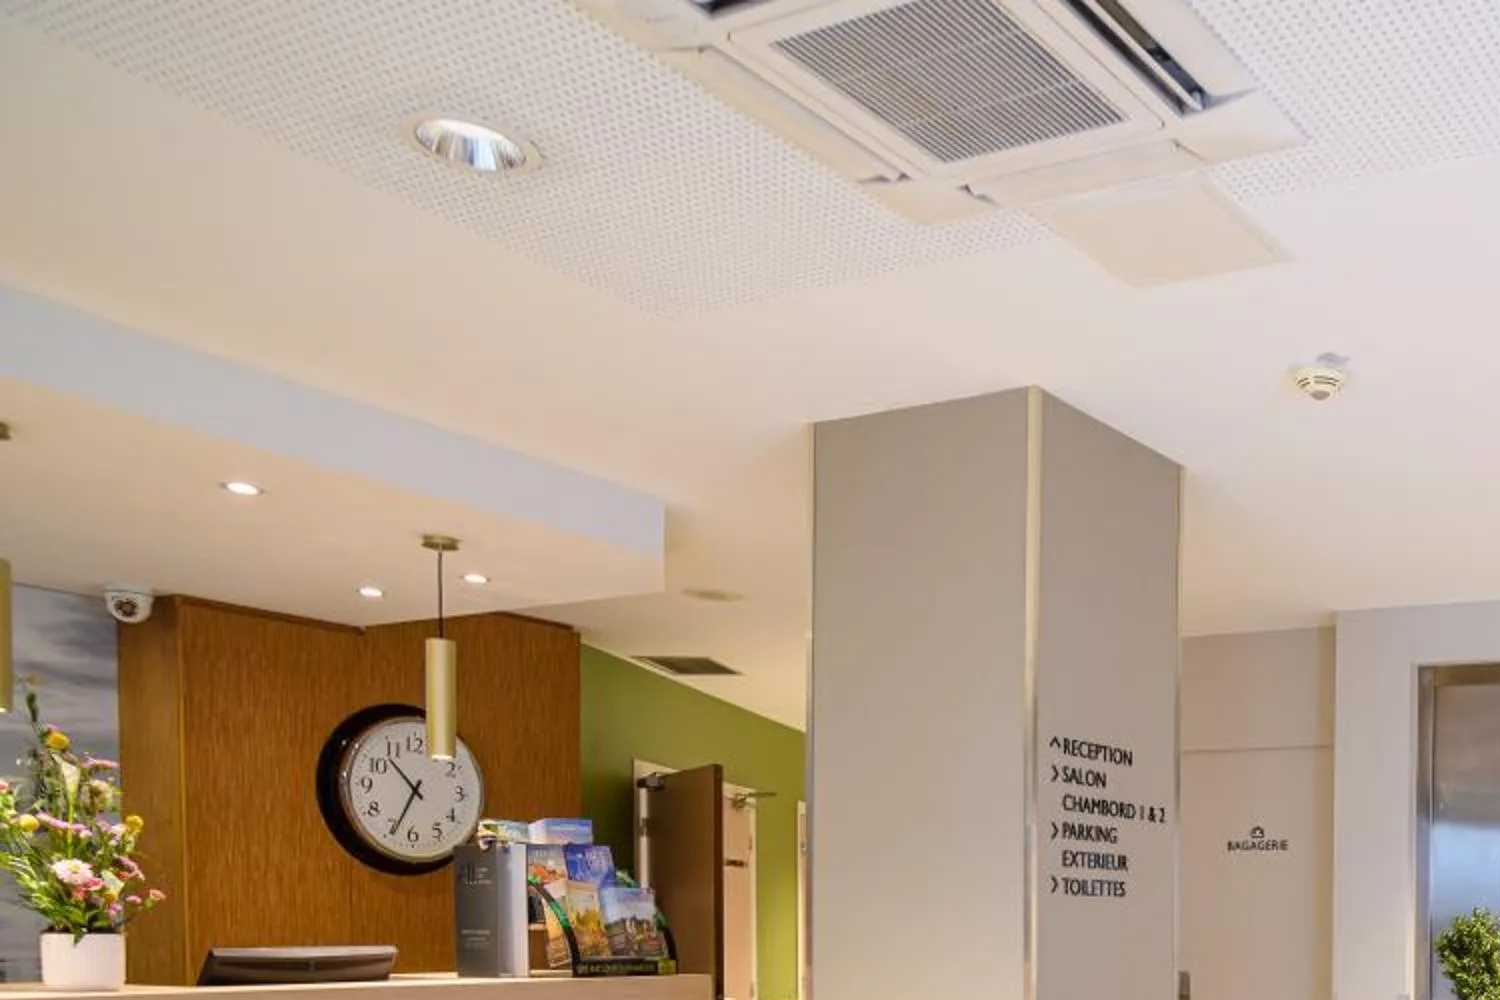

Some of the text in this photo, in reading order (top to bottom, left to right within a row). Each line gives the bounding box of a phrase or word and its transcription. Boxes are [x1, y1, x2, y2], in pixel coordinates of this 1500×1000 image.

[385, 739, 401, 758] 11
[406, 735, 423, 754] 12
[1062, 737, 1133, 767] RECEPTION
[368, 757, 388, 775] 10
[445, 761, 457, 778] 2
[360, 776, 373, 794] 9
[1061, 765, 1107, 788] SALON
[454, 785, 466, 802] 3
[367, 801, 380, 817] 8
[445, 807, 455, 823] 4
[1061, 793, 1137, 820] CHAMBORD
[1147, 805, 1157, 823] &
[1158, 806, 1166, 823] 2
[407, 826, 419, 842] 6
[431, 822, 443, 840] 5
[1061, 821, 1119, 845] PARKING
[1061, 849, 1129, 872] EXTERIEUR
[1060, 876, 1127, 898] TOILETTES
